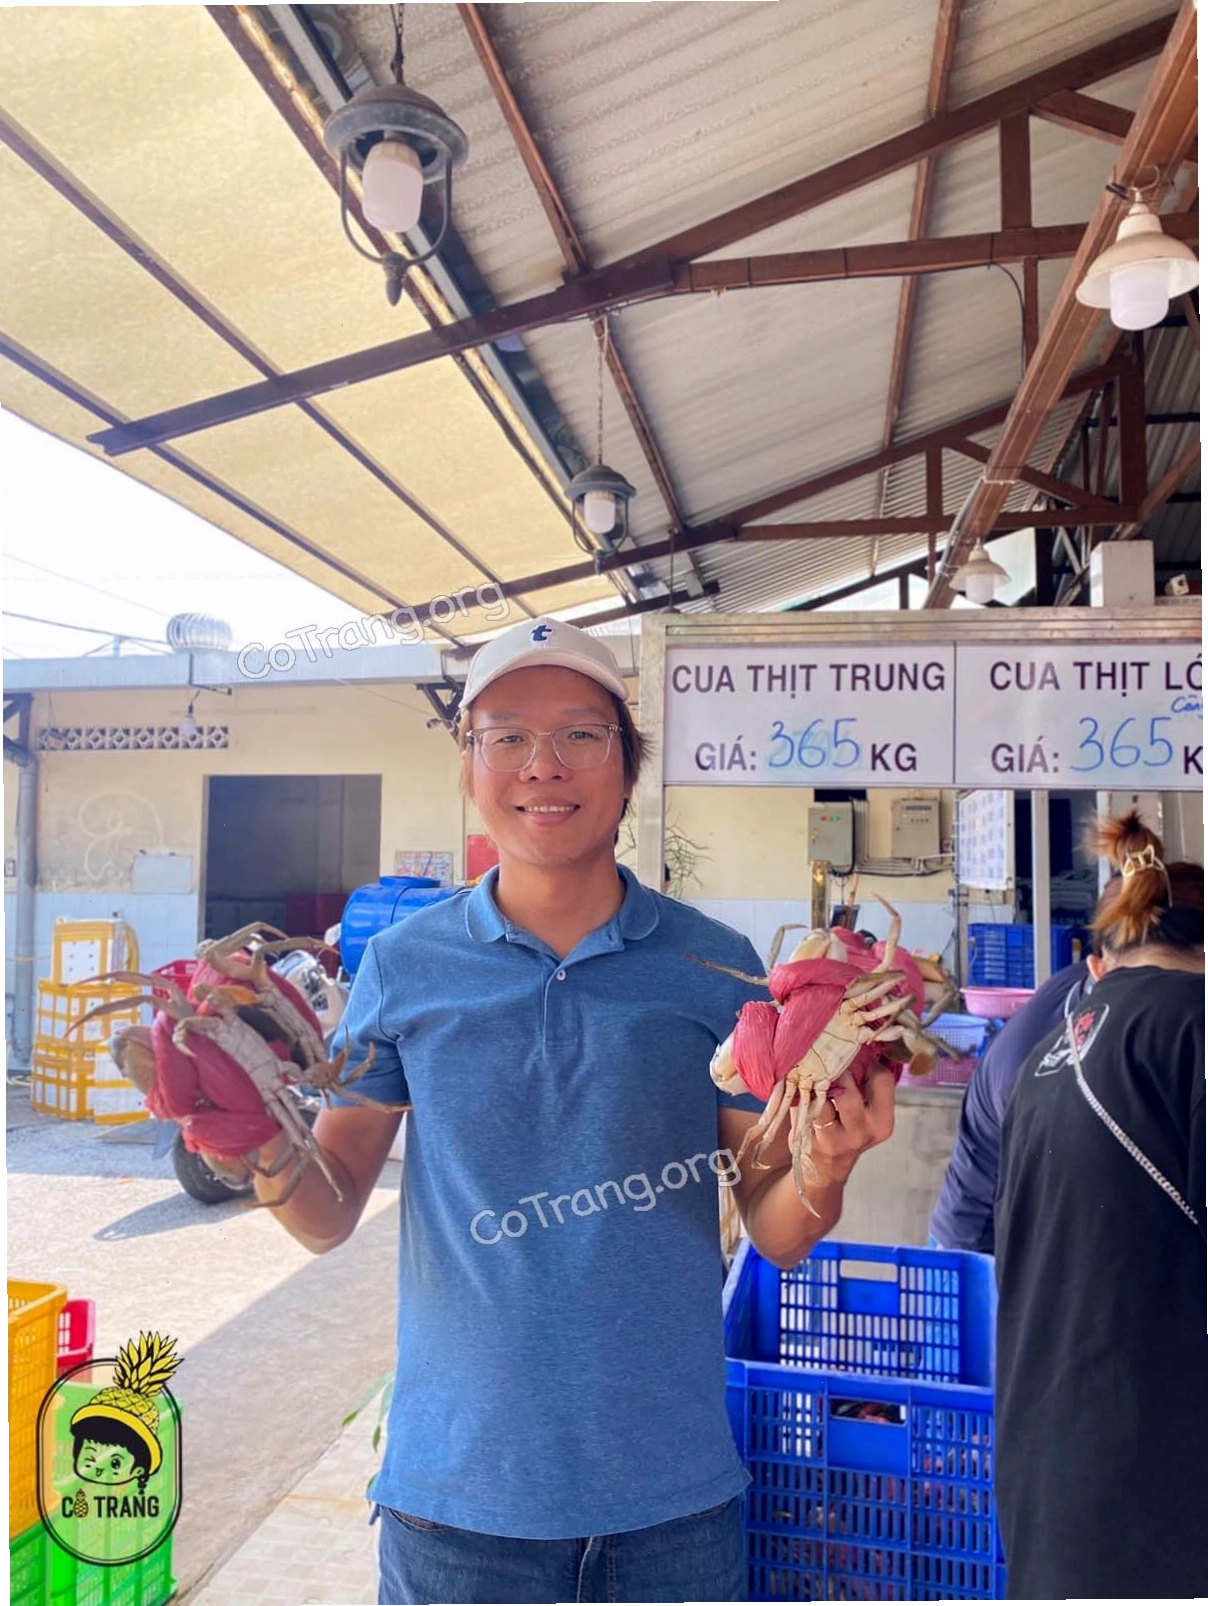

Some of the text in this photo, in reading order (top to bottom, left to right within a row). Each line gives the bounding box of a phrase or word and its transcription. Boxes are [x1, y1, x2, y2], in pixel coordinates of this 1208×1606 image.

[672, 662, 945, 699] CUA THỊT TRUNG
[990, 661, 1060, 691] CUA
[1073, 661, 1150, 698] THỊT
[695, 717, 917, 771] GIÁ: 365 KG
[991, 735, 1059, 773] GIÁ:
[1070, 717, 1173, 771] 365
